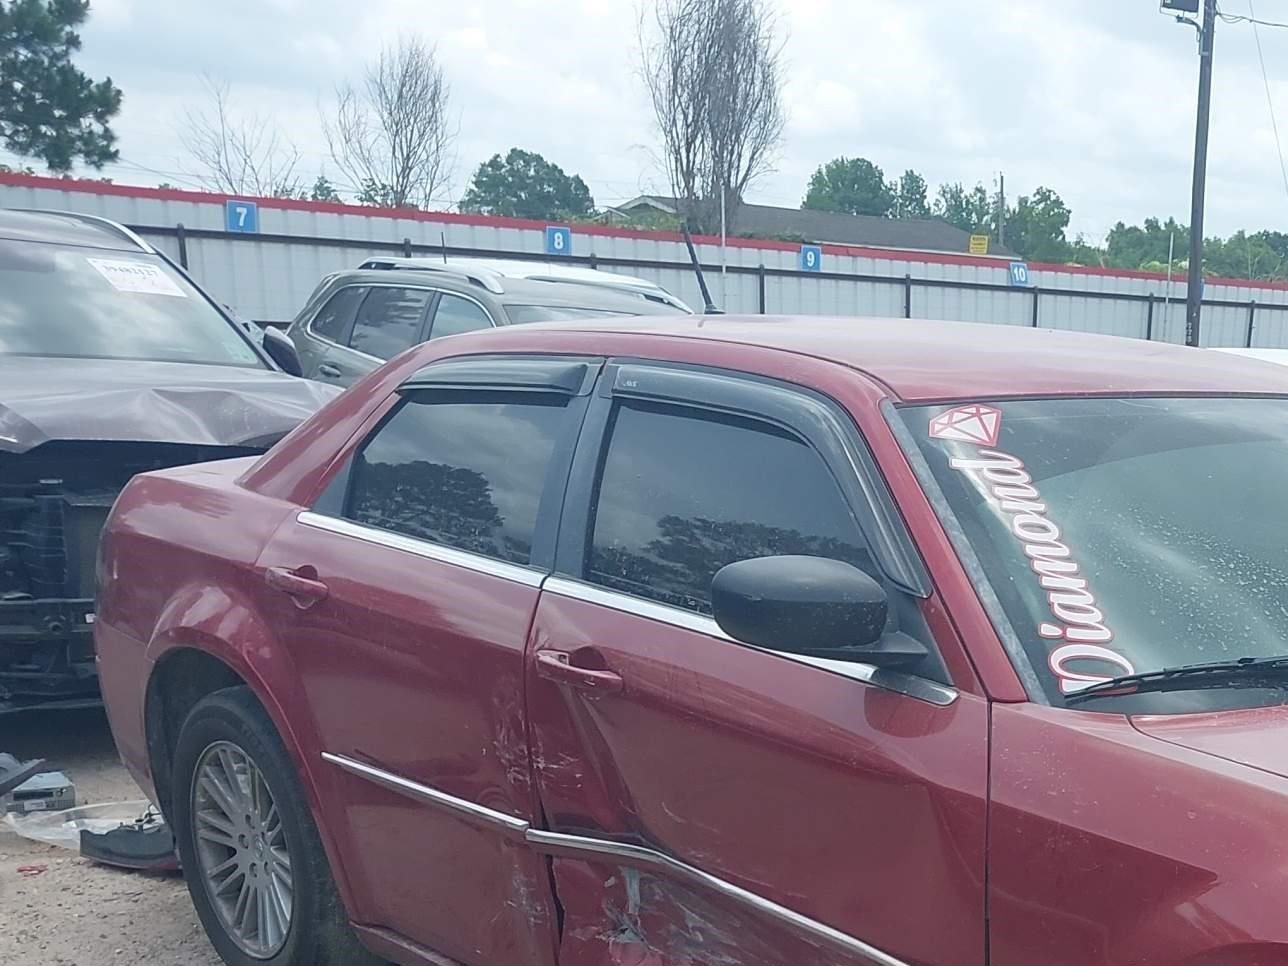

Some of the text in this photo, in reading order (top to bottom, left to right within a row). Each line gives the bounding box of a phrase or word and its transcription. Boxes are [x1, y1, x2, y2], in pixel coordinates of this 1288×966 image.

[236, 207, 247, 227] 7
[554, 232, 564, 249] 8
[807, 251, 815, 267] 9
[1014, 267, 1026, 281] 10
[950, 449, 1137, 696] Diamond
